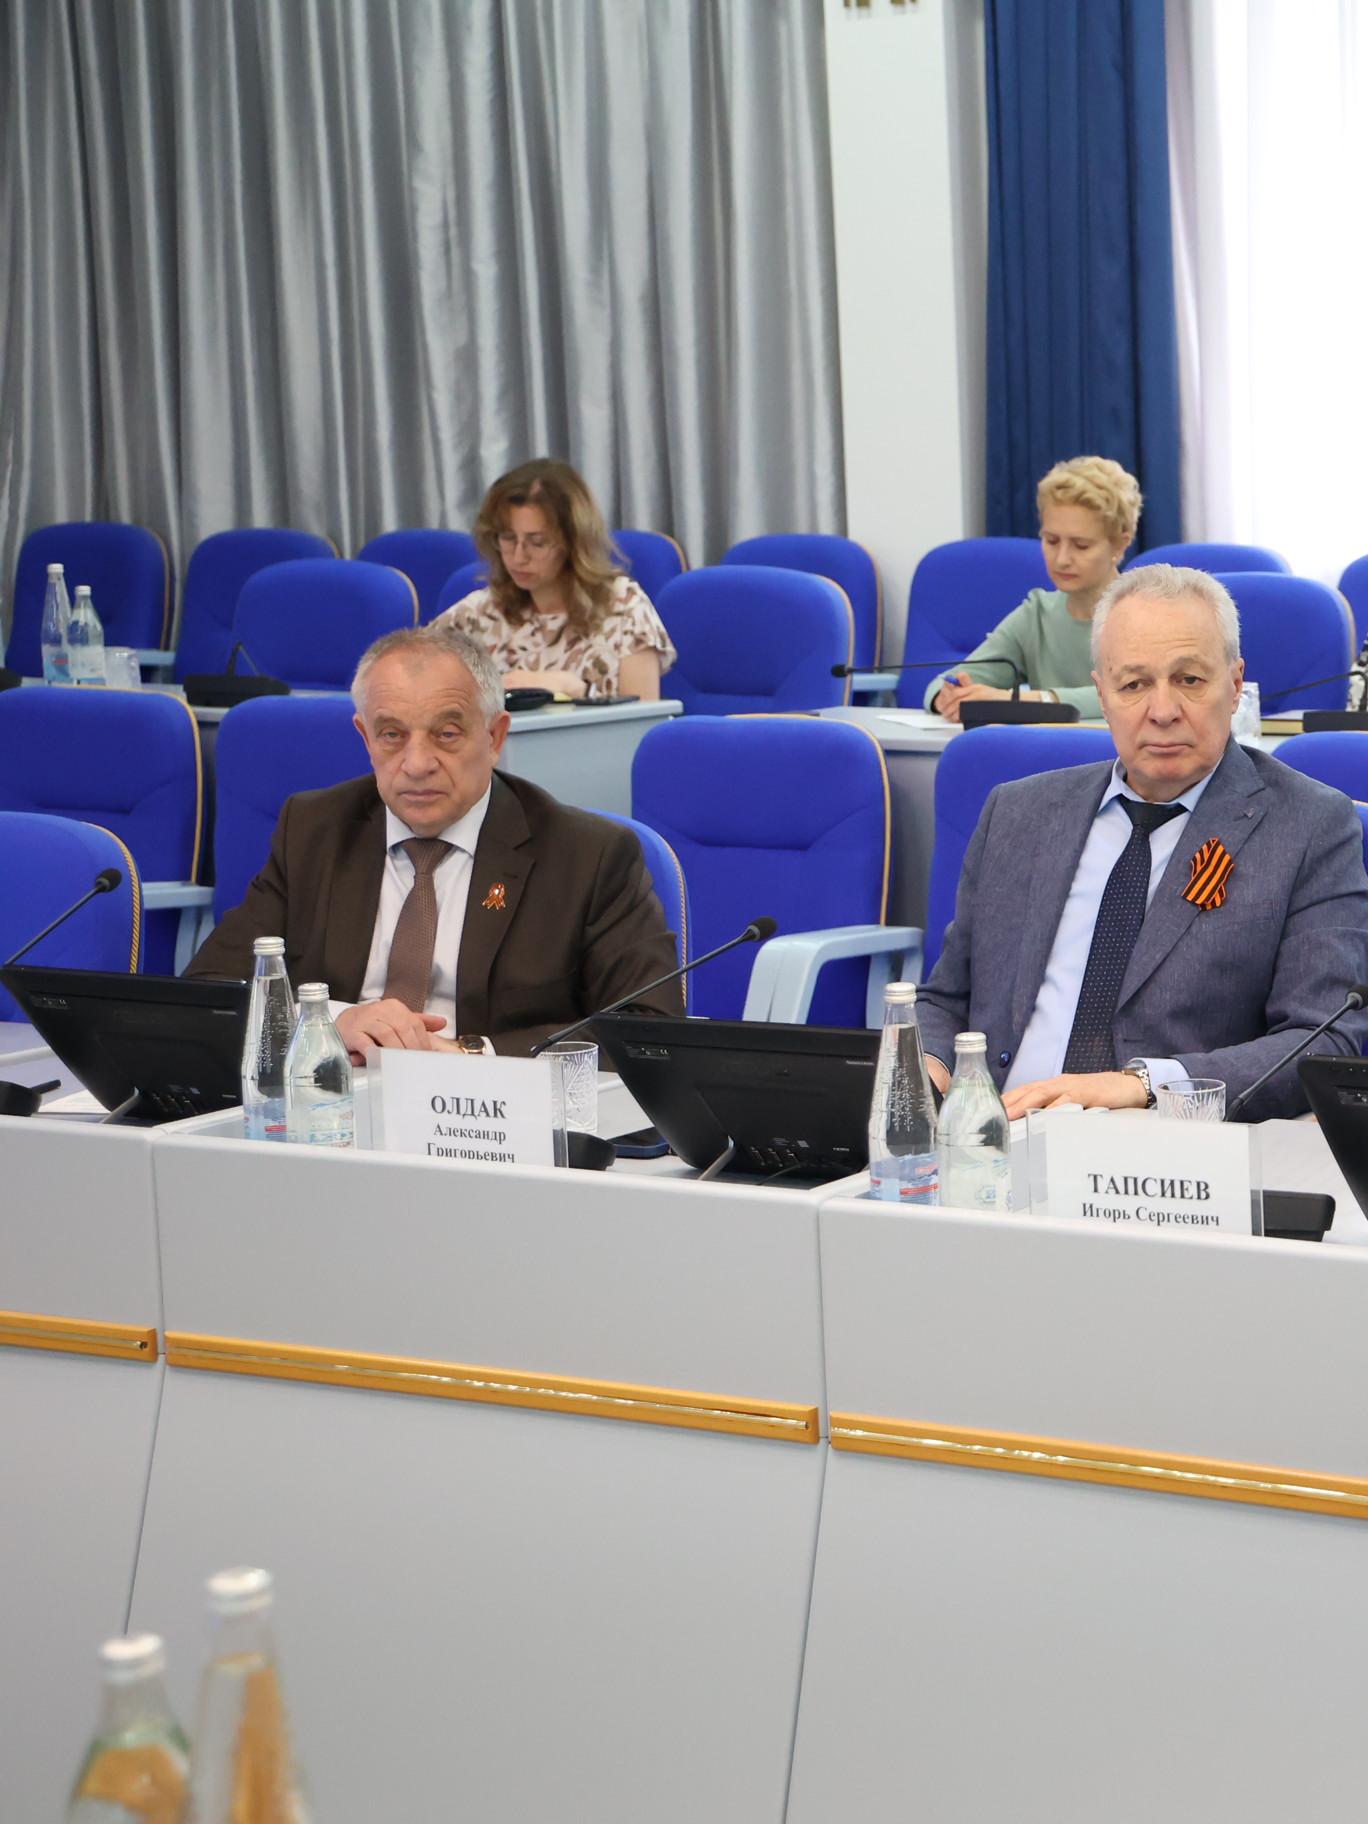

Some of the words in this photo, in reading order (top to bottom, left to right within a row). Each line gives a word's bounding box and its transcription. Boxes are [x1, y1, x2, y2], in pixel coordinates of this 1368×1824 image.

[430, 1095, 507, 1120] ОЛДАК
[433, 1123, 507, 1145] Александр
[427, 1142, 515, 1163] Григорьевич
[1087, 1173, 1211, 1201] ТАПСИЕВ
[1082, 1202, 1131, 1223] Игорь
[1135, 1206, 1220, 1227] Сергеевич
